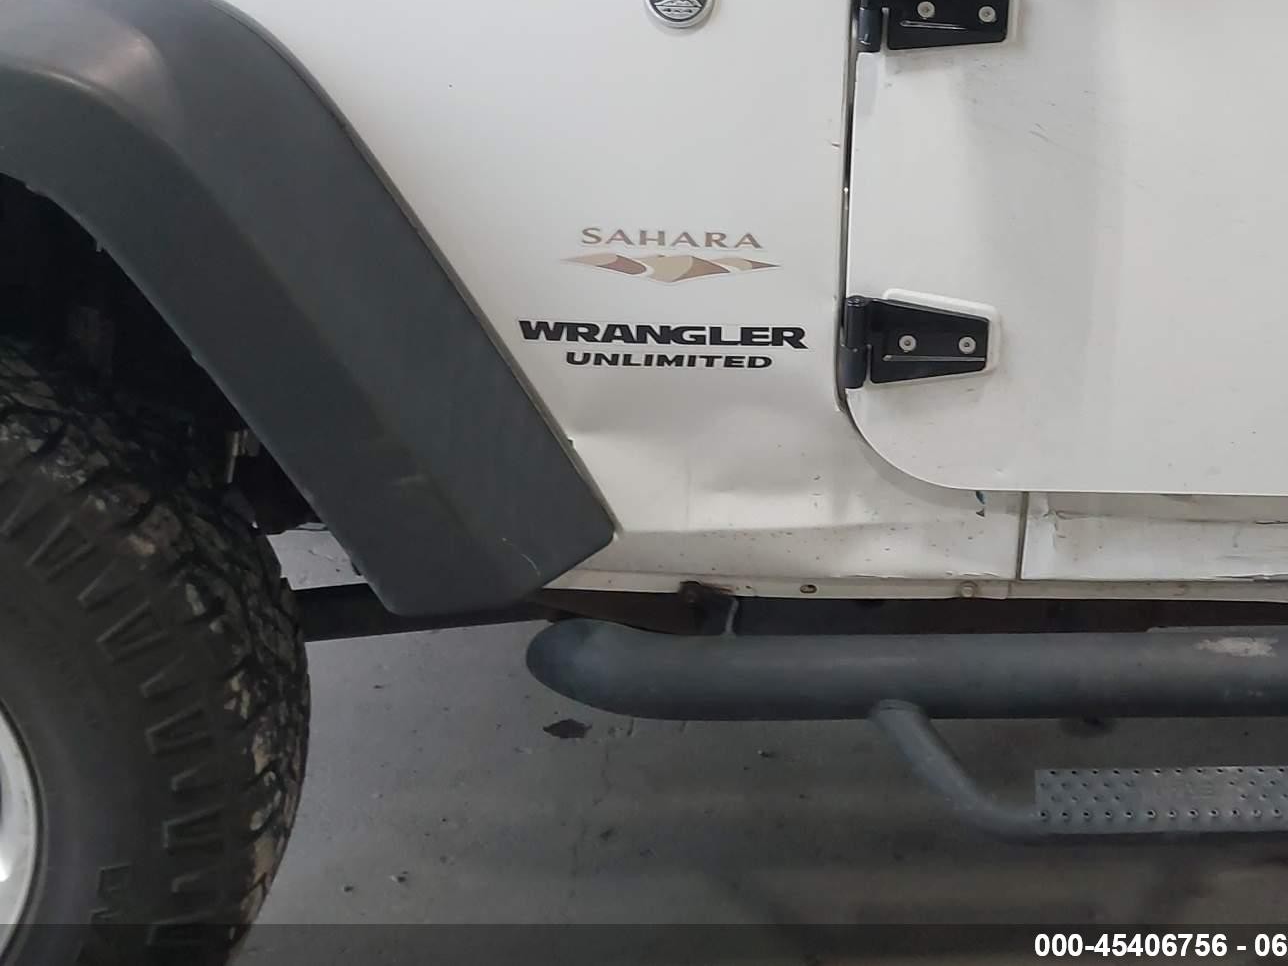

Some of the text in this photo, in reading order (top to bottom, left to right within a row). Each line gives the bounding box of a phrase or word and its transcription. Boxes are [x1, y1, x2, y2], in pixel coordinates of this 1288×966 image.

[581, 227, 763, 249] SAHARA
[518, 320, 808, 349] WRANGLER
[566, 352, 773, 368] UNLIMITED
